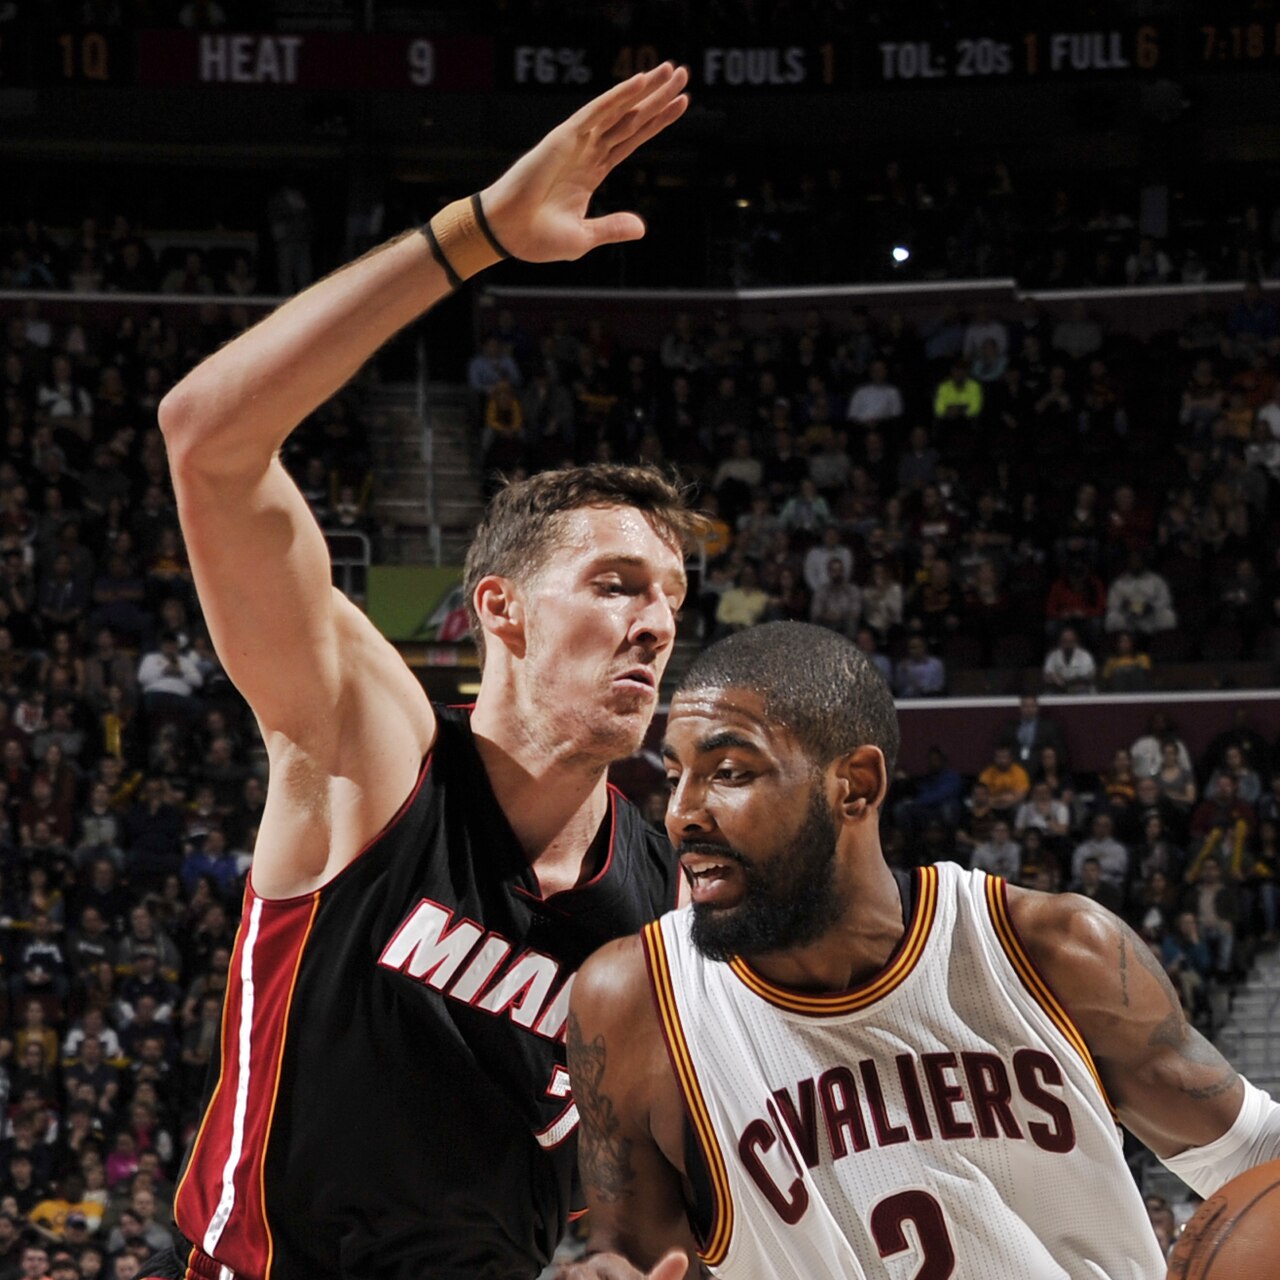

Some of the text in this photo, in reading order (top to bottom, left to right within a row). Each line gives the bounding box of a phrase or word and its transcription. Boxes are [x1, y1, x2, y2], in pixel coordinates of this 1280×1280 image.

[57, 31, 113, 81] 1Q
[198, 34, 437, 87] HEAT 9
[513, 45, 592, 85] FG%
[704, 42, 837, 86] FOULS 1
[1021, 31, 1040, 77] 1
[1049, 31, 1131, 72] FULL
[1134, 24, 1162, 71] 6
